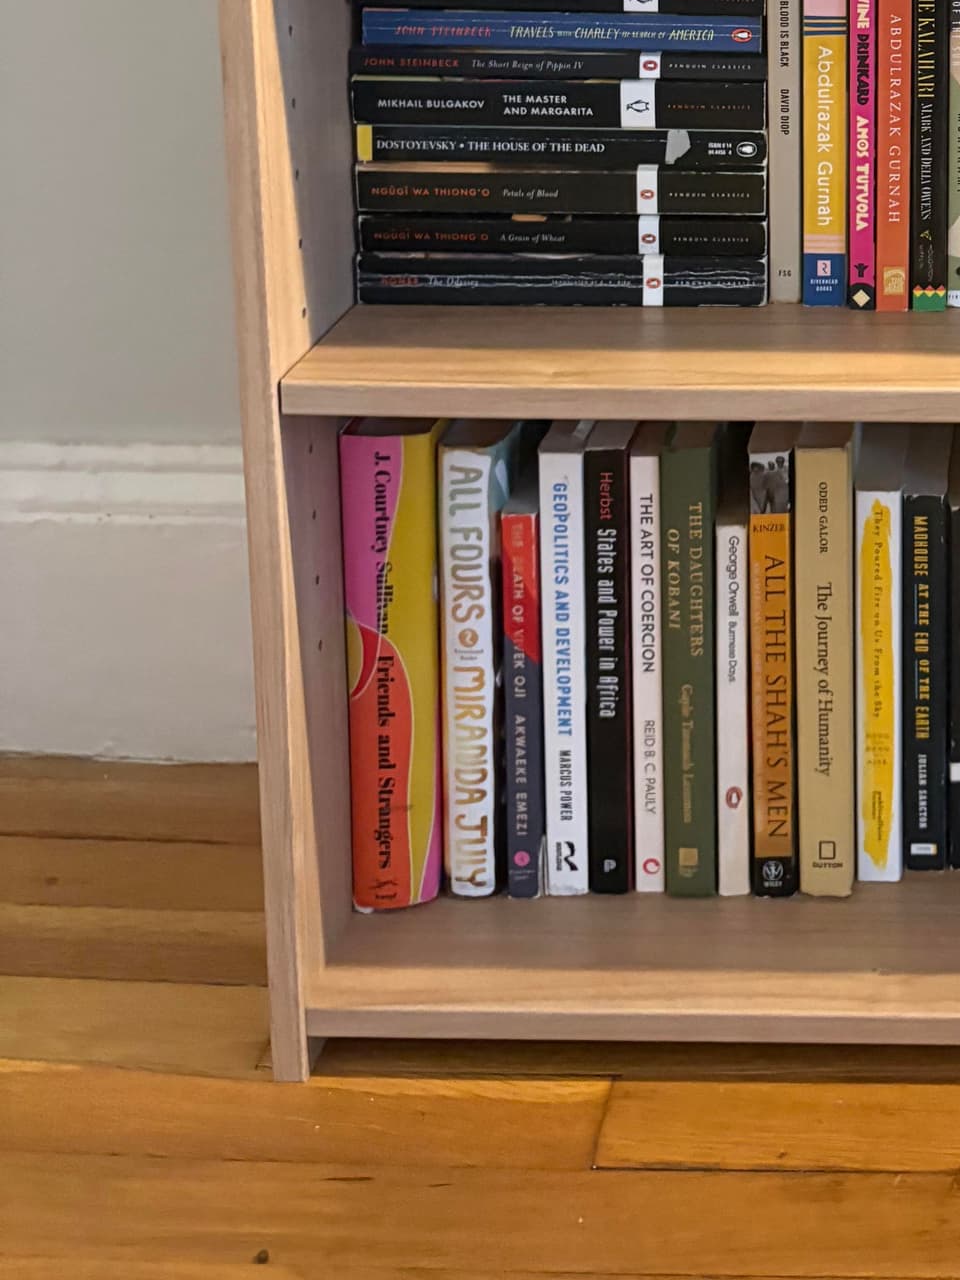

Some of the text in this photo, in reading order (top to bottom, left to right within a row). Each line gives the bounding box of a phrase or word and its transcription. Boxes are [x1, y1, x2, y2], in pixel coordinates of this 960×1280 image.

[817, 46, 835, 226] Abdulrazak Gurnah
[448, 465, 482, 516] ALL
[451, 528, 485, 622] FOURS
[553, 483, 573, 736] GEOPOLITICS AND DEVELOPMENT
[597, 529, 618, 717] States and Power in Africa
[668, 529, 680, 628] OF KOBANI
[689, 503, 704, 656] THE DAUGHTERS
[375, 656, 396, 869] Friends and Strangers
[454, 667, 488, 805] MIRANDA
[765, 555, 788, 837] ALL THE SHAH'S MEN
[454, 815, 488, 887] JULY
